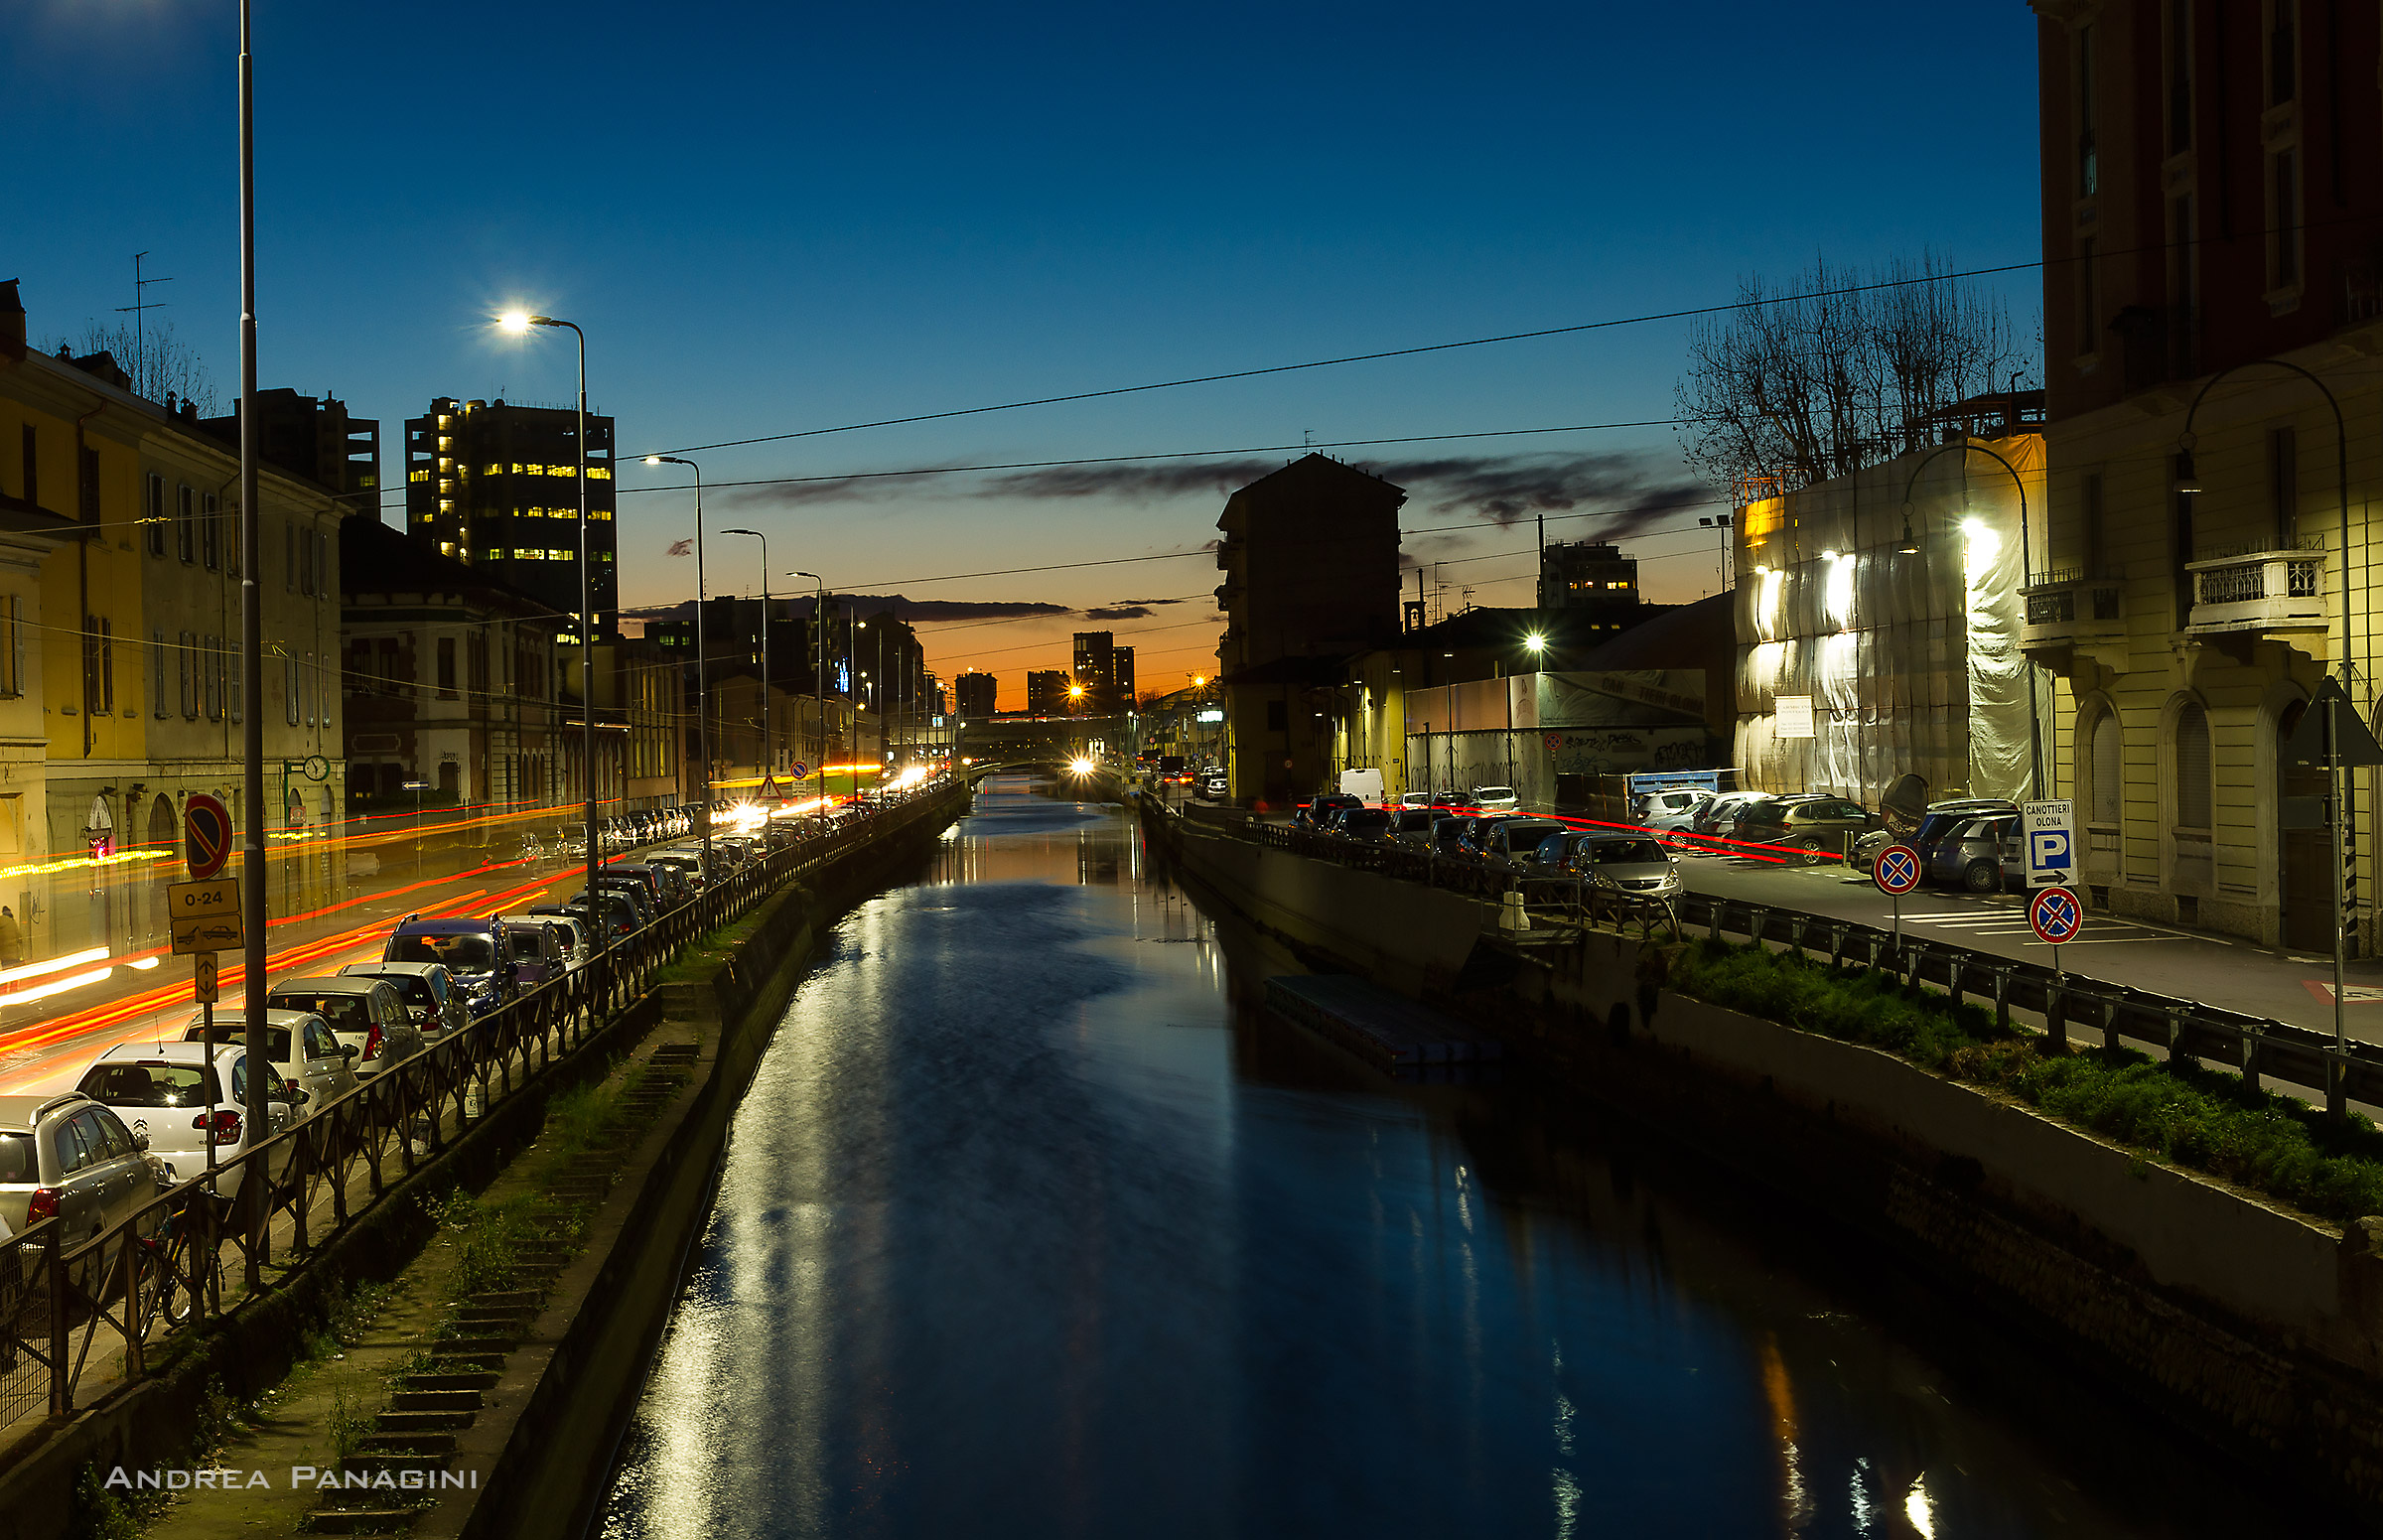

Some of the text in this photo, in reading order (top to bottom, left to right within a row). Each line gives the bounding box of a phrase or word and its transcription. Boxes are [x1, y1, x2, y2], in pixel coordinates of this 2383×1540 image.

[2026, 803, 2070, 816] CANOTTIERI
[2035, 816, 2062, 827] OLONA
[2033, 834, 2067, 866] P
[185, 891, 223, 907] 0-24
